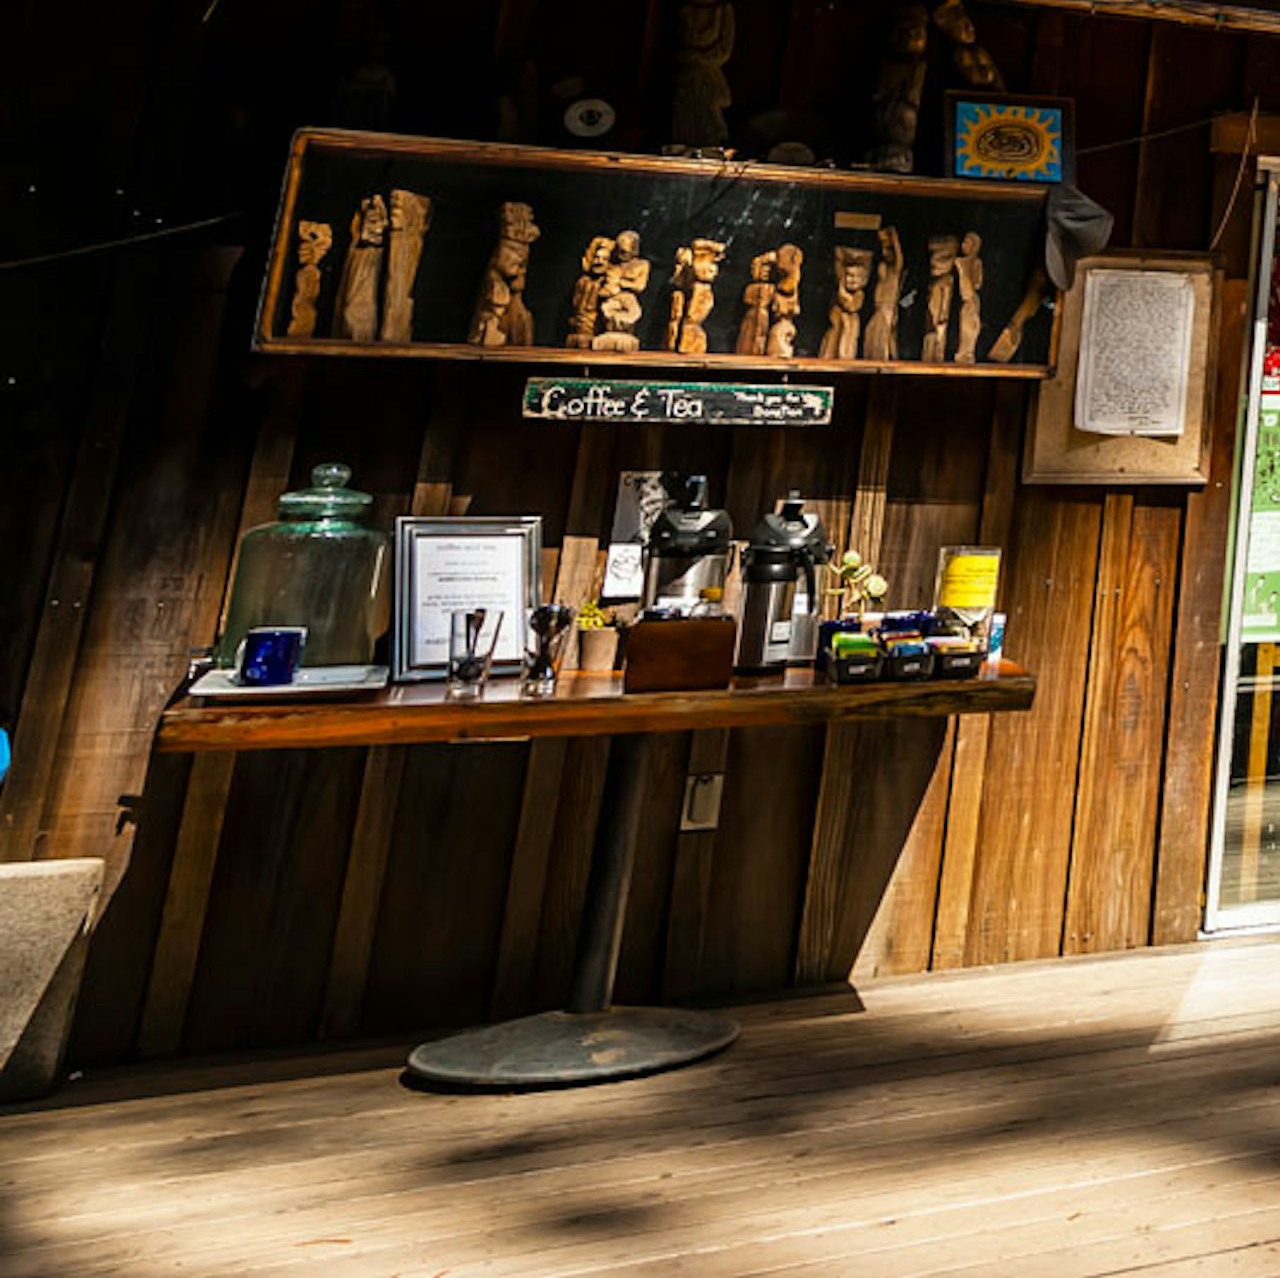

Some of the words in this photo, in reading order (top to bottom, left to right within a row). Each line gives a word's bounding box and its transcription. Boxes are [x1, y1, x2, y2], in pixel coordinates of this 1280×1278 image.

[541, 386, 626, 418] Coffee
[631, 384, 650, 420] &
[657, 388, 704, 418] Tea
